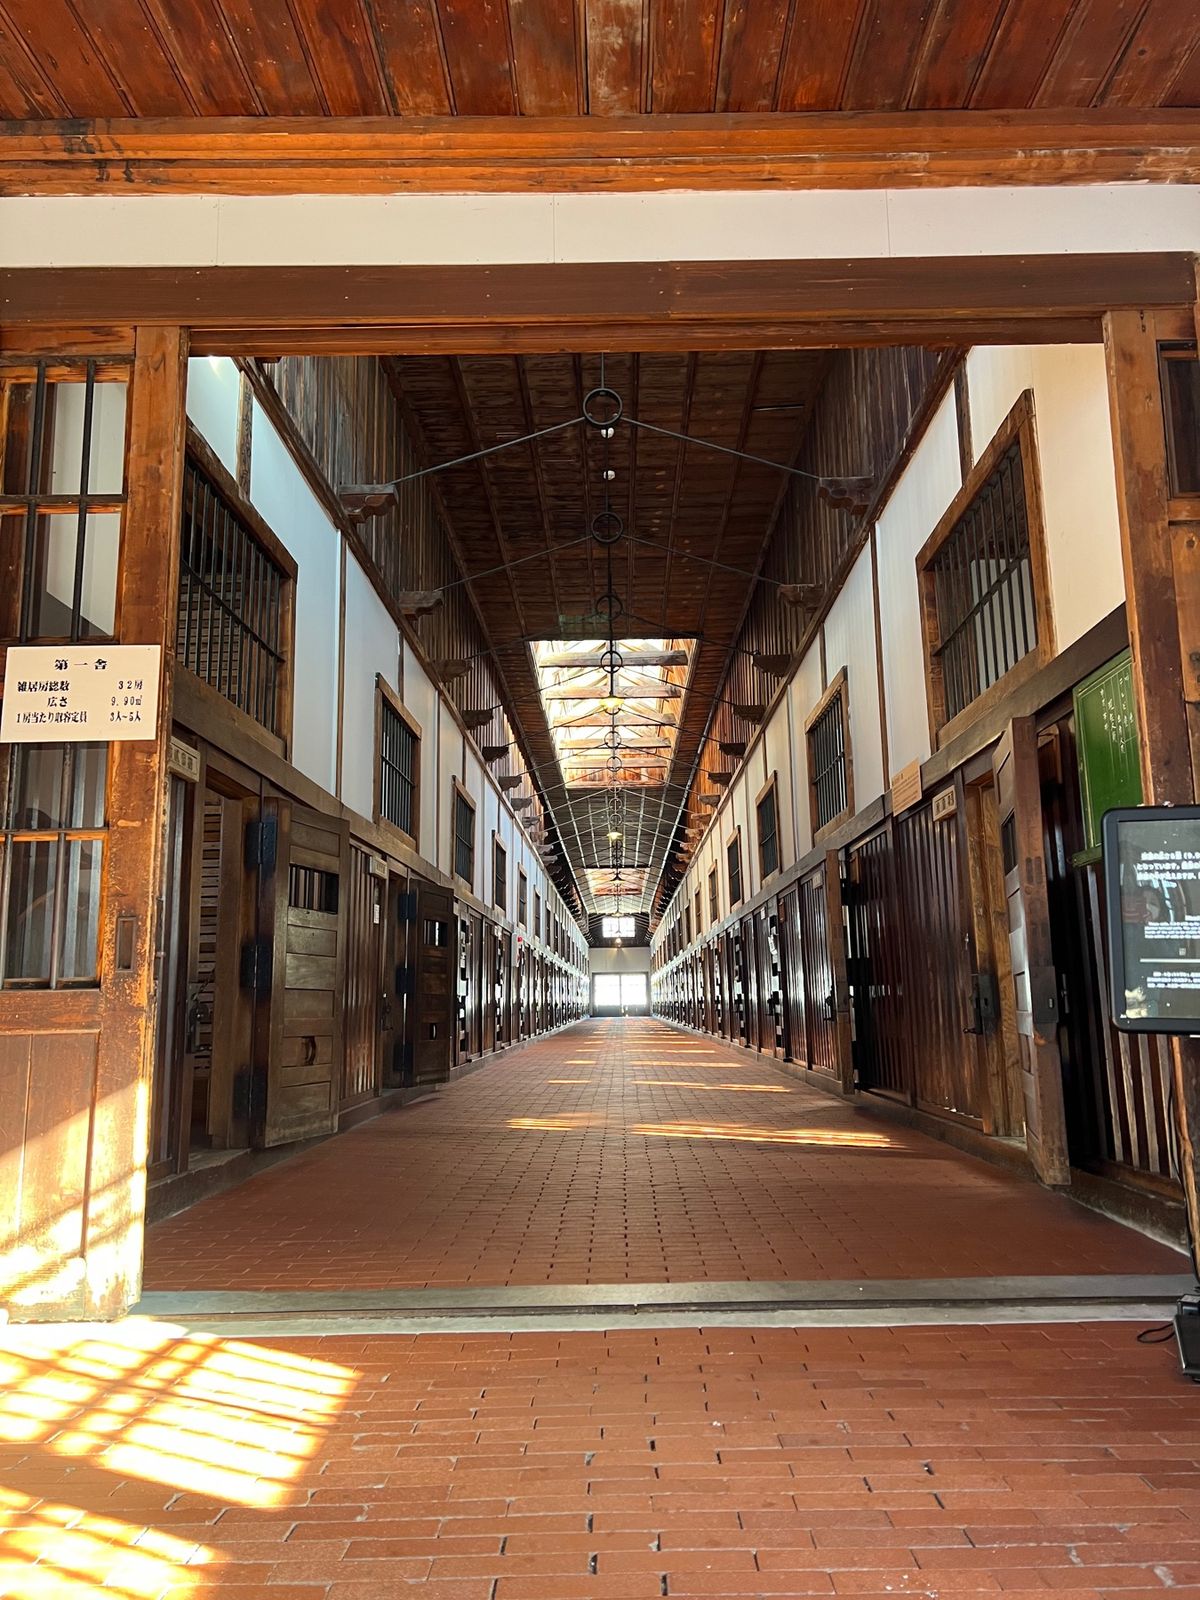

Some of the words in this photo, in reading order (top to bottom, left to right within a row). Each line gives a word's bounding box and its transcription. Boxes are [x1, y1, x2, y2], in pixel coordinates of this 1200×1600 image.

[54, 658, 108, 670] 第一舎
[47, 696, 68, 707] 広さ
